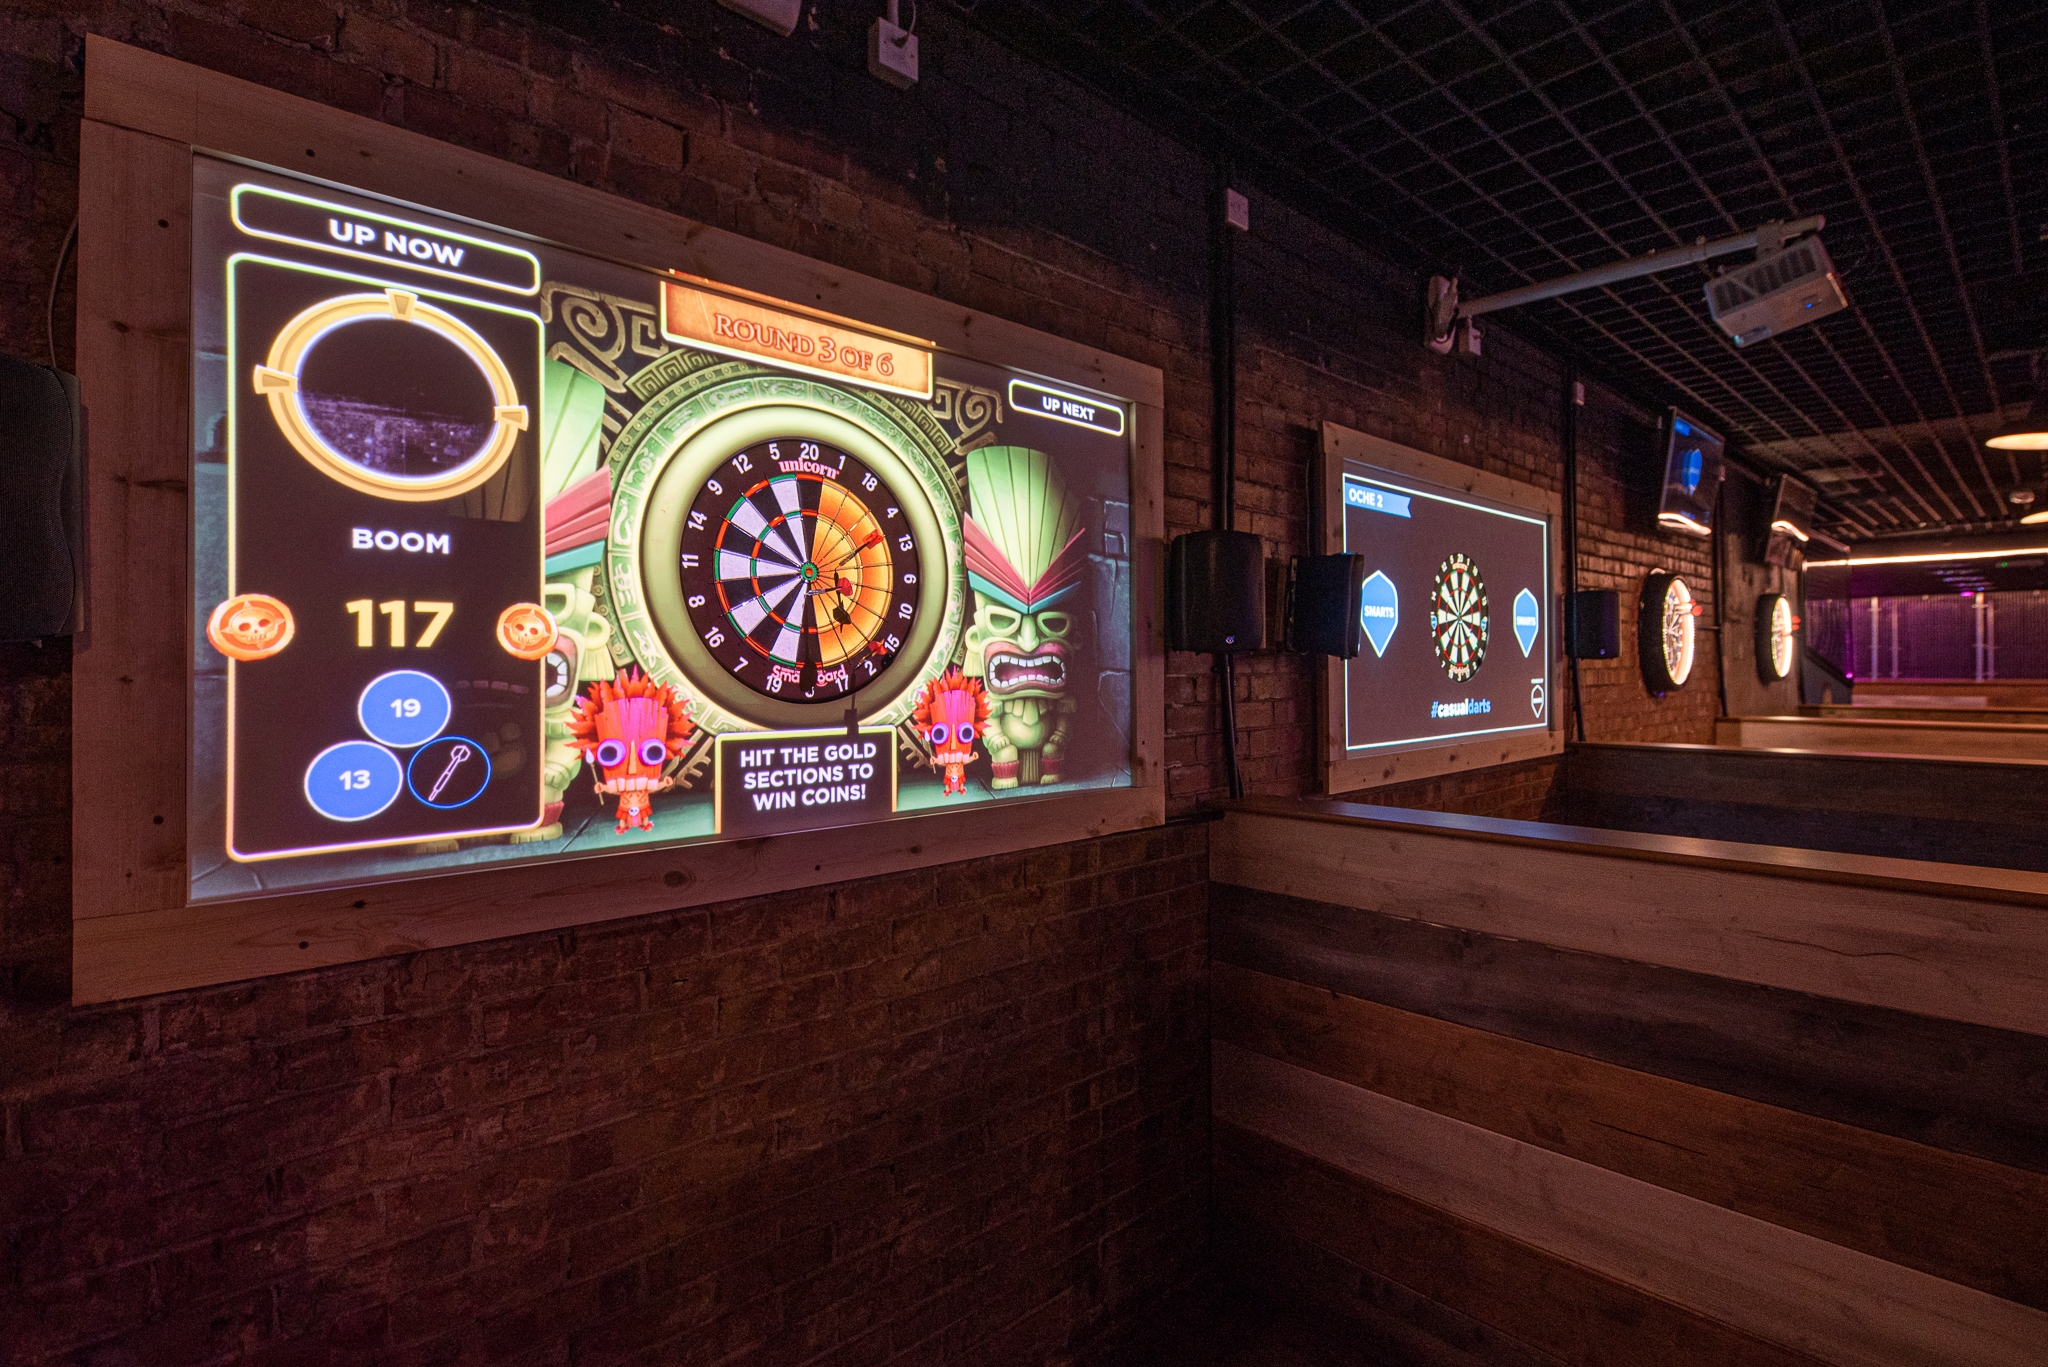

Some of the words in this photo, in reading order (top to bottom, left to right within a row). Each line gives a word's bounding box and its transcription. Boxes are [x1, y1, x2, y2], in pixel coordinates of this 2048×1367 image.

[328, 218, 376, 246] UP
[384, 231, 465, 267] NOW
[714, 313, 815, 357] ROUND
[818, 337, 836, 363] 3
[840, 347, 873, 371] OF
[876, 353, 894, 377] 6
[1042, 396, 1060, 411] UP
[1062, 401, 1095, 421] NEXT
[768, 443, 780, 460] 5
[800, 443, 819, 461] 20
[732, 454, 753, 474] 12
[778, 458, 838, 480] unicorn
[839, 455, 846, 470] 1
[707, 479, 723, 495] 9
[861, 472, 878, 492] 18
[1348, 488, 1376, 506] OCHE
[1376, 494, 1383, 508] 2
[688, 510, 708, 531] 14
[886, 507, 899, 519] 4
[352, 527, 451, 555] BOOM
[898, 534, 913, 552] 13
[681, 553, 699, 569] 11
[903, 573, 917, 585] 6
[688, 595, 705, 608] 8
[898, 603, 913, 620] 10
[1363, 604, 1395, 619] SMARTS
[346, 599, 454, 648] 117
[704, 626, 725, 648] 16
[884, 633, 900, 653] 15
[733, 656, 749, 673] 7
[864, 660, 877, 676] 2
[766, 675, 783, 693] 19
[835, 674, 849, 692] 17
[390, 698, 421, 718] 19
[1431, 697, 1491, 719] #casualdarts
[740, 749, 775, 768] HIT
[780, 746, 819, 765] THE
[824, 742, 877, 761] GOLD
[339, 769, 371, 790] 13
[743, 765, 844, 789] SECTIONS
[848, 763, 874, 780] TO
[752, 790, 796, 811] WIN
[801, 783, 866, 806] COINS!
